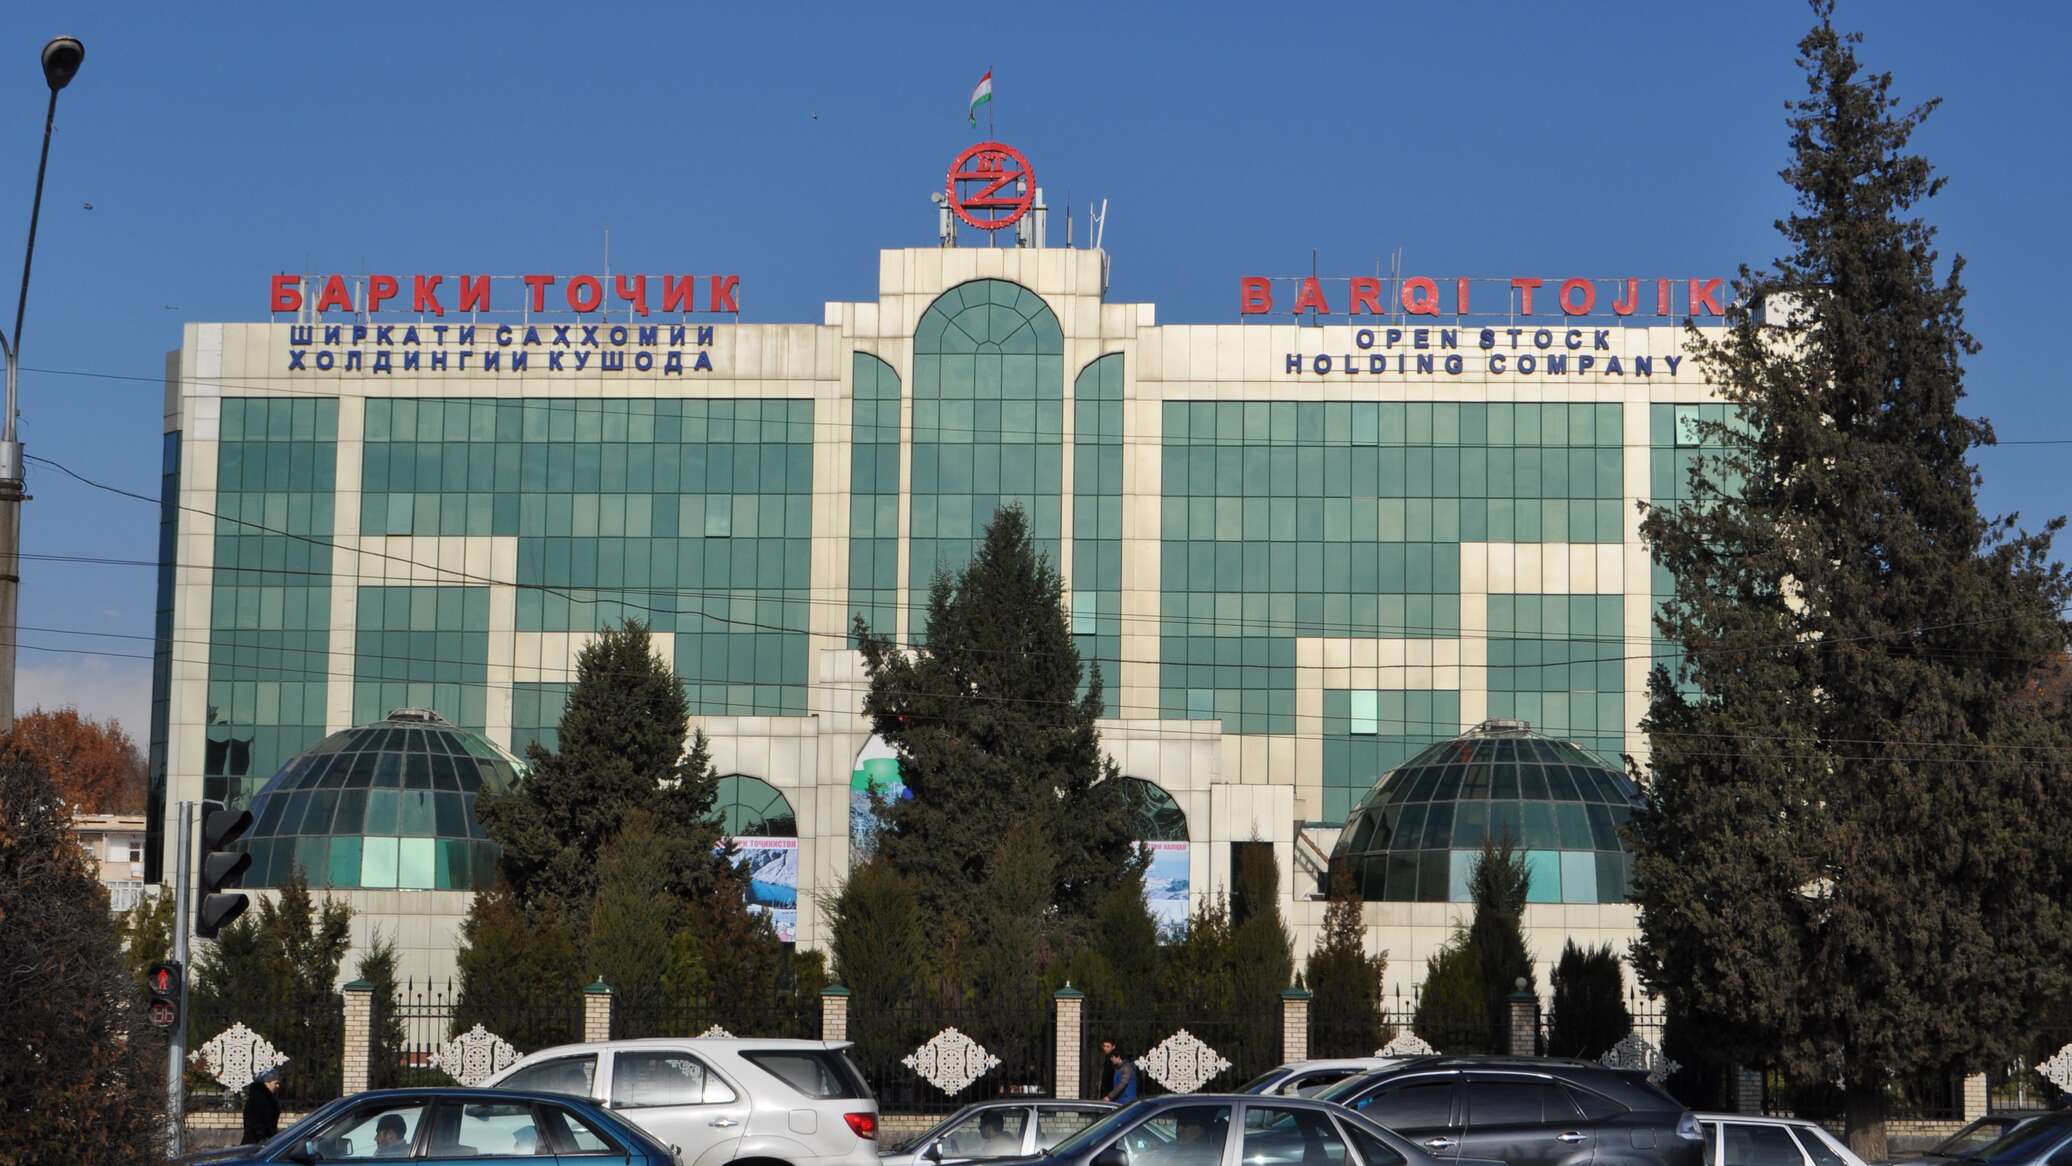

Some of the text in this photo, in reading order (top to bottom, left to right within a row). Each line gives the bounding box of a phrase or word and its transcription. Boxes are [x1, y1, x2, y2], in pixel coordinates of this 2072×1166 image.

[271, 275, 740, 317] БАРҚИ ТОҶИК
[1241, 276, 1725, 318] BARQI TOJIK
[290, 325, 714, 349] ШИРКАТИ САҲҲОМИИ
[1356, 329, 1610, 350] OPEN STOCK
[288, 350, 713, 375] ХОЛДИНГИИ КУШОДА
[1286, 353, 1682, 377] HOLDING COMPANY
